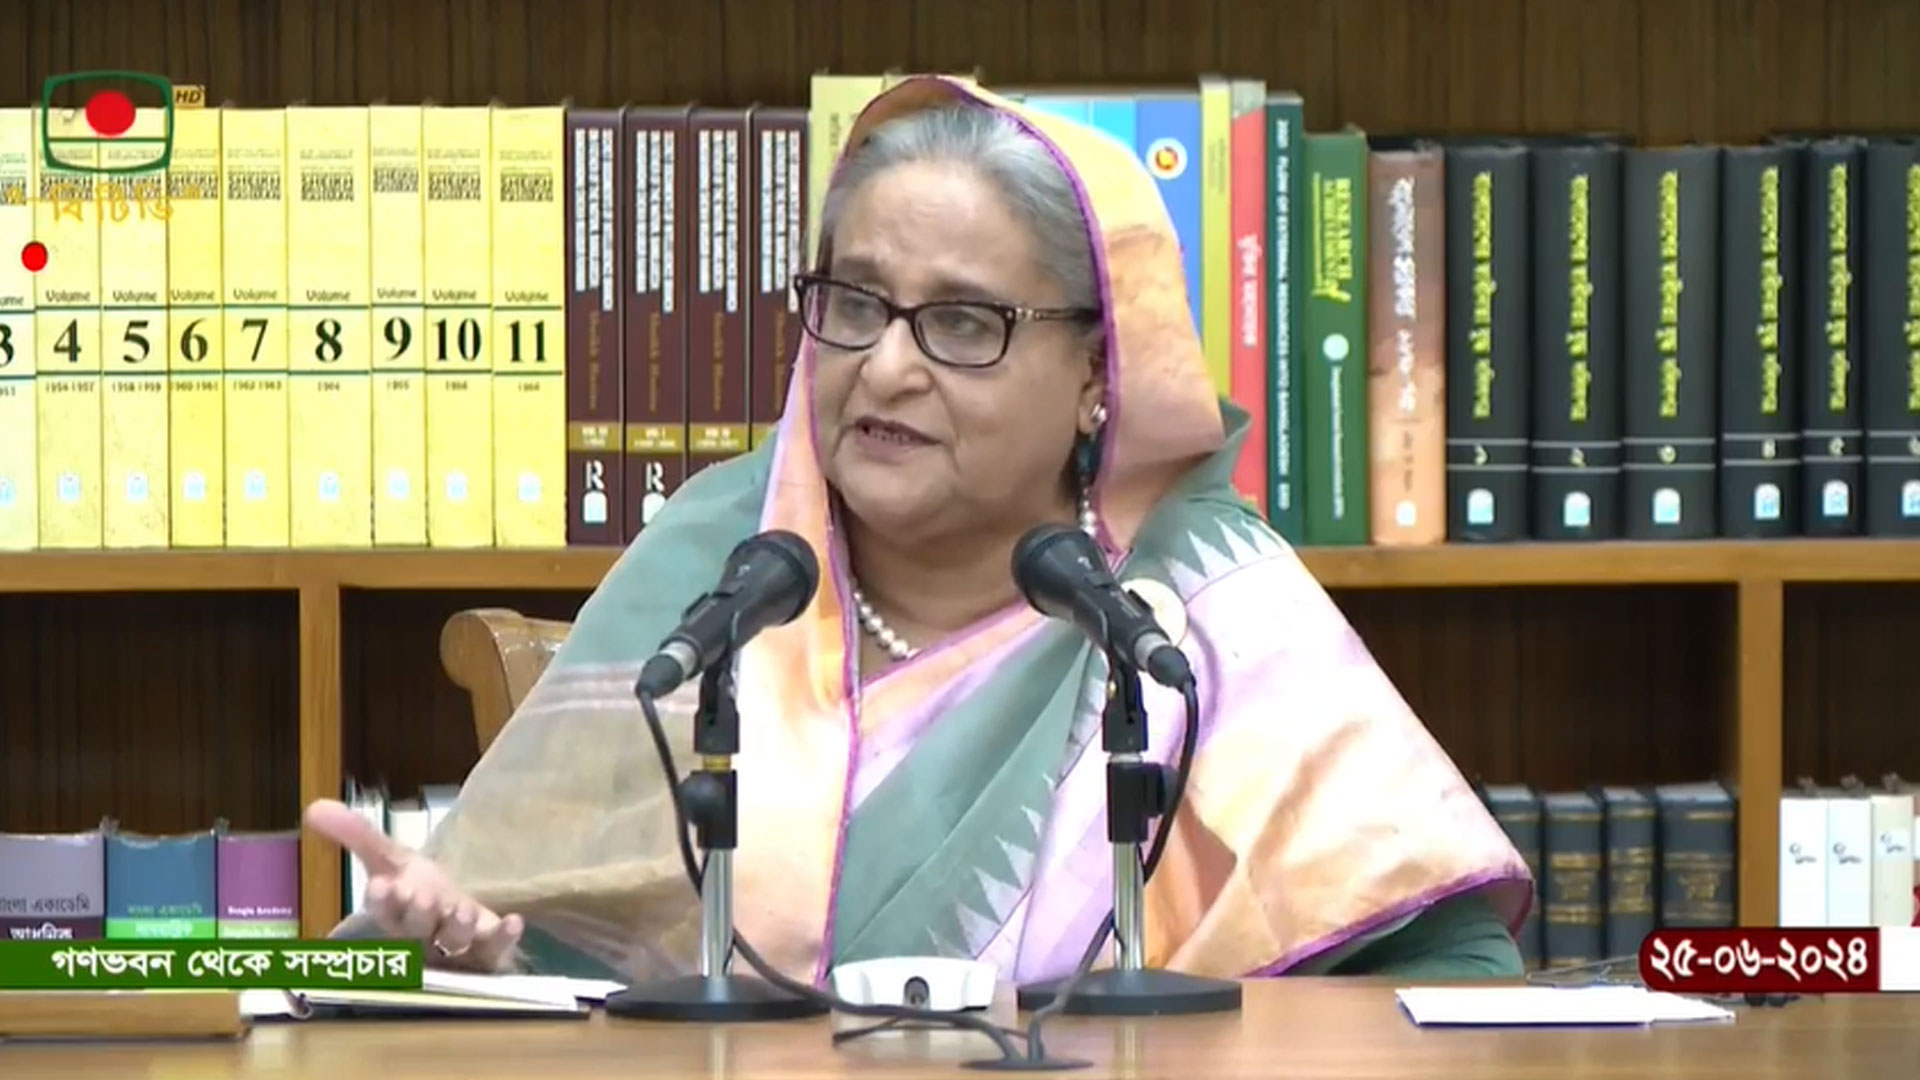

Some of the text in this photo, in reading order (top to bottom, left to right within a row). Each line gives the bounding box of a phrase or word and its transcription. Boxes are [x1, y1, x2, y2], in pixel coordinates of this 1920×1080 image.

[46, 290, 91, 302] Volume
[113, 290, 157, 302] Volume
[171, 289, 216, 301] Volume
[234, 288, 278, 301] Volume
[306, 289, 351, 302] Volume
[377, 288, 417, 300] Volume
[432, 289, 477, 302] Volume
[504, 291, 549, 303] Volume
[53, 318, 82, 363] 4
[123, 320, 150, 364] 5
[180, 317, 209, 362] 6
[241, 318, 269, 362] 7
[315, 318, 343, 363] 8
[383, 316, 412, 361] 9
[433, 317, 481, 361] 10
[508, 319, 547, 362] 11
[1278, 391, 1291, 476] BANGLADESH
[586, 460, 605, 491] R
[645, 461, 665, 492] R
